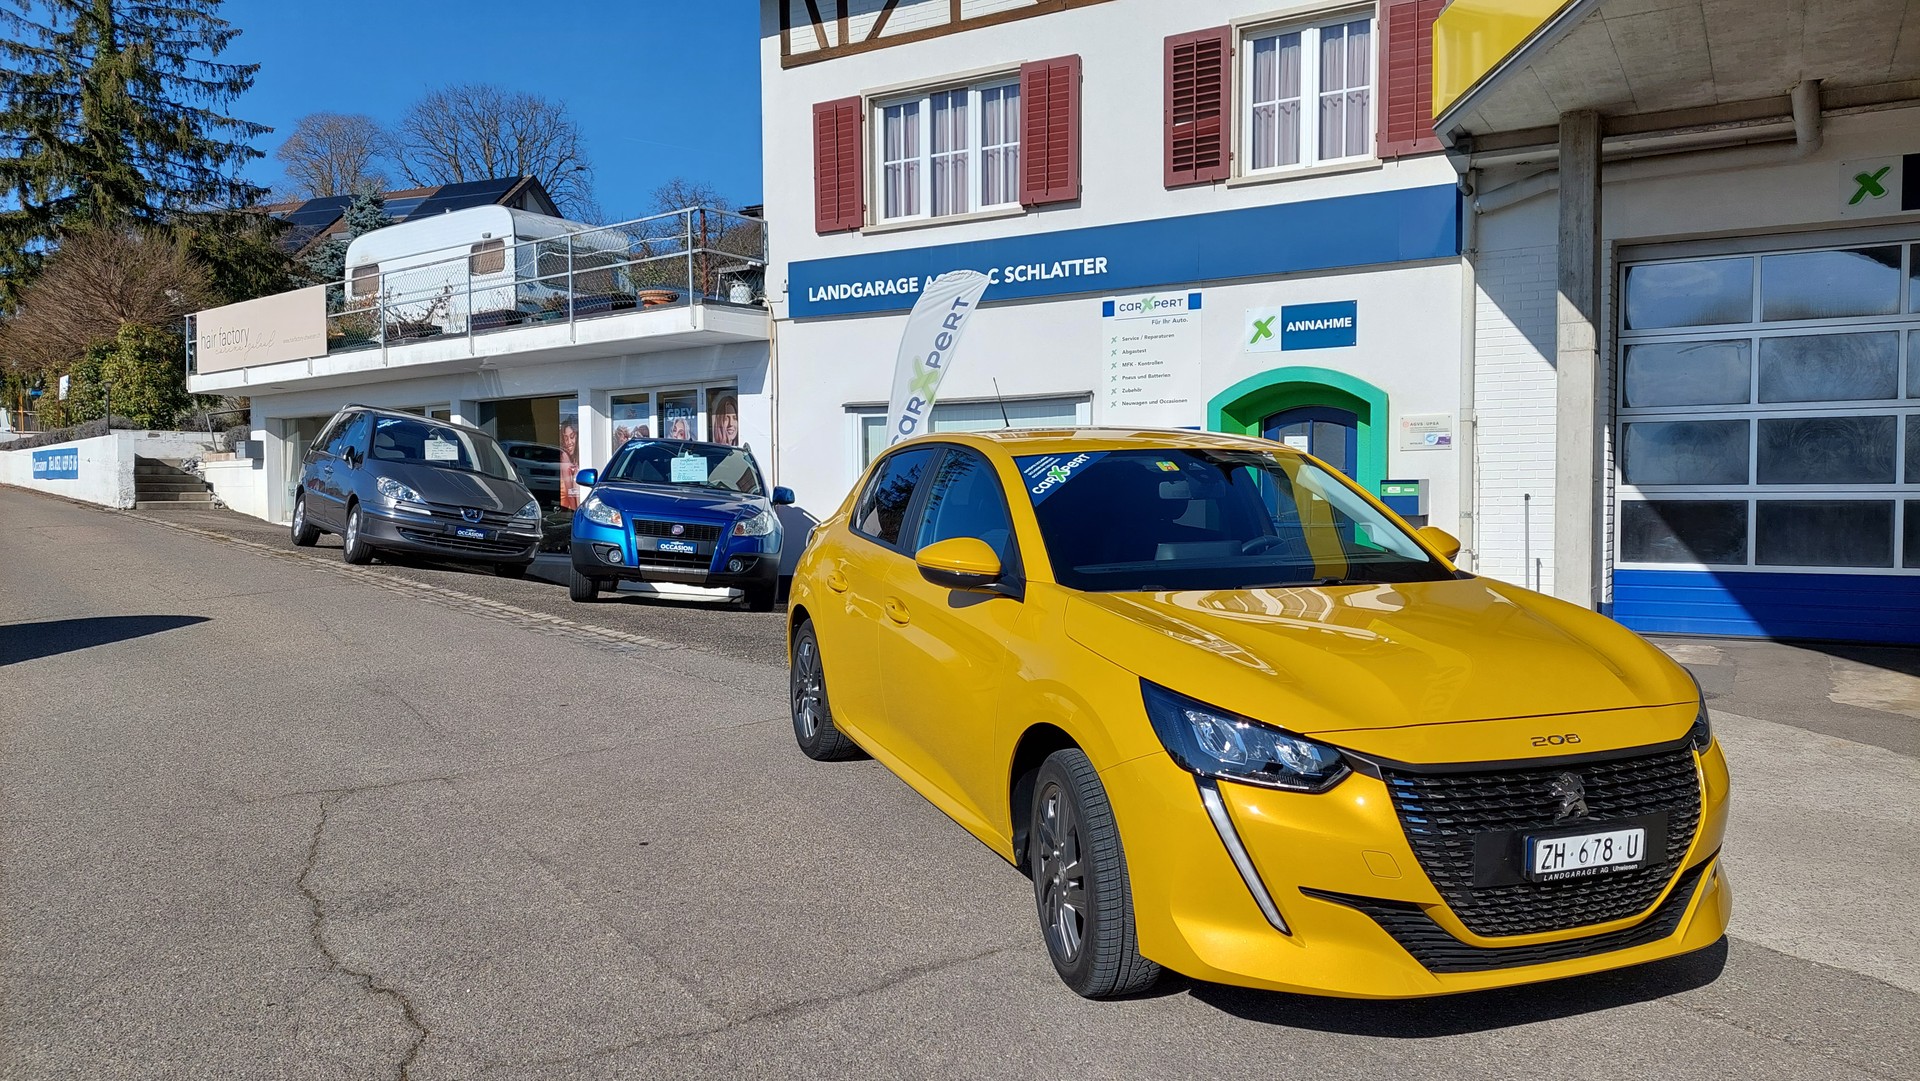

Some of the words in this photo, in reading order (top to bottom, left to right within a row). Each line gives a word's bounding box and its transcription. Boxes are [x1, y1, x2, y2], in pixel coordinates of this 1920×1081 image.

[808, 276, 919, 303] LANDGARAGE
[1004, 256, 1108, 283] SCHLATTER
[1286, 317, 1352, 332] ANNAHME
[200, 329, 217, 350] hair
[218, 326, 250, 348] factory
[1144, 333, 1175, 341] Reparaturen
[1122, 348, 1147, 356] Abgastest
[666, 407, 695, 420] GREY.
[457, 529, 484, 538] OCCASION
[660, 543, 694, 551] OCCASION
[1530, 733, 1582, 747] 208
[1541, 843, 1566, 870] ZH
[1578, 837, 1614, 865] 678
[1626, 834, 1639, 859] U
[1543, 869, 1597, 881] LANDGARAGE
